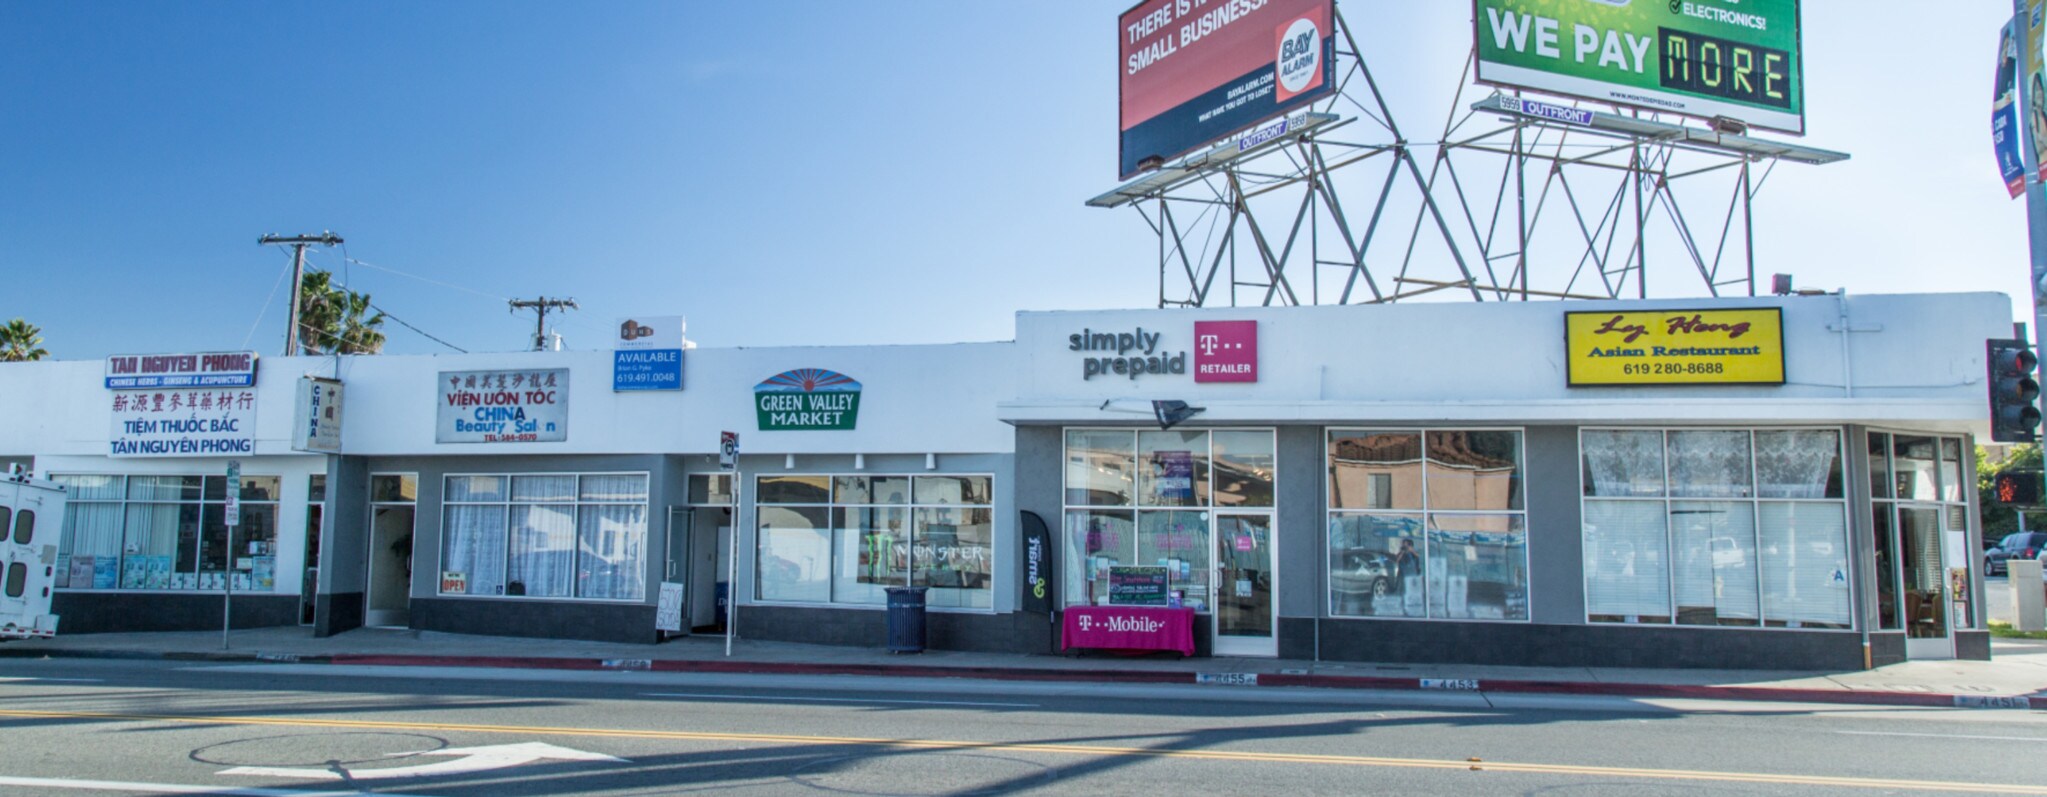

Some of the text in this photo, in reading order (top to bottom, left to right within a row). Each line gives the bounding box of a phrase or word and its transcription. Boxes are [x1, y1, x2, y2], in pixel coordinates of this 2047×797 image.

[1128, 0, 1190, 44] THERE IS
[1683, 2, 1766, 30] ELECTRONICS!
[1128, 0, 1268, 75] SMALL BUSINES
[1281, 28, 1315, 63] BAY
[1486, 7, 1652, 74] WE PAY
[1281, 53, 1314, 77] ALARM
[1668, 35, 1783, 99] MORE
[1527, 102, 1587, 122] OUTFRONT
[1242, 123, 1283, 148] OUTFRONT
[1593, 314, 1751, 343] Ly Hong
[1069, 327, 1161, 355] simply
[618, 351, 677, 363] AVAILABLE
[1587, 345, 1761, 358] Asian Restaurant
[111, 353, 251, 374] TAN NGUYEN PHONG
[1083, 351, 1186, 381] prepaid
[1200, 363, 1251, 374] RETAILER
[1623, 363, 1724, 375] 619 280-8688
[110, 377, 137, 386] CHINESE
[137, 377, 158, 386] HERBS
[163, 376, 192, 385] GINSENG
[201, 375, 248, 385] ACUPUNCTURE
[616, 373, 676, 383] 619.491.0048
[525, 388, 556, 404] TÓC
[760, 394, 854, 411] GREEN VALLEY
[310, 385, 320, 438] CHINA
[474, 406, 526, 421] CHINA
[770, 411, 844, 426] MARKET
[124, 411, 239, 437] TIỆM THUỐC BẮC
[456, 419, 506, 434] Beauty
[111, 436, 251, 454] TÂN NGUYÊN PHONG
[892, 543, 984, 561] MONSTER
[443, 579, 465, 591] OPEN
[1834, 570, 1845, 581] A
